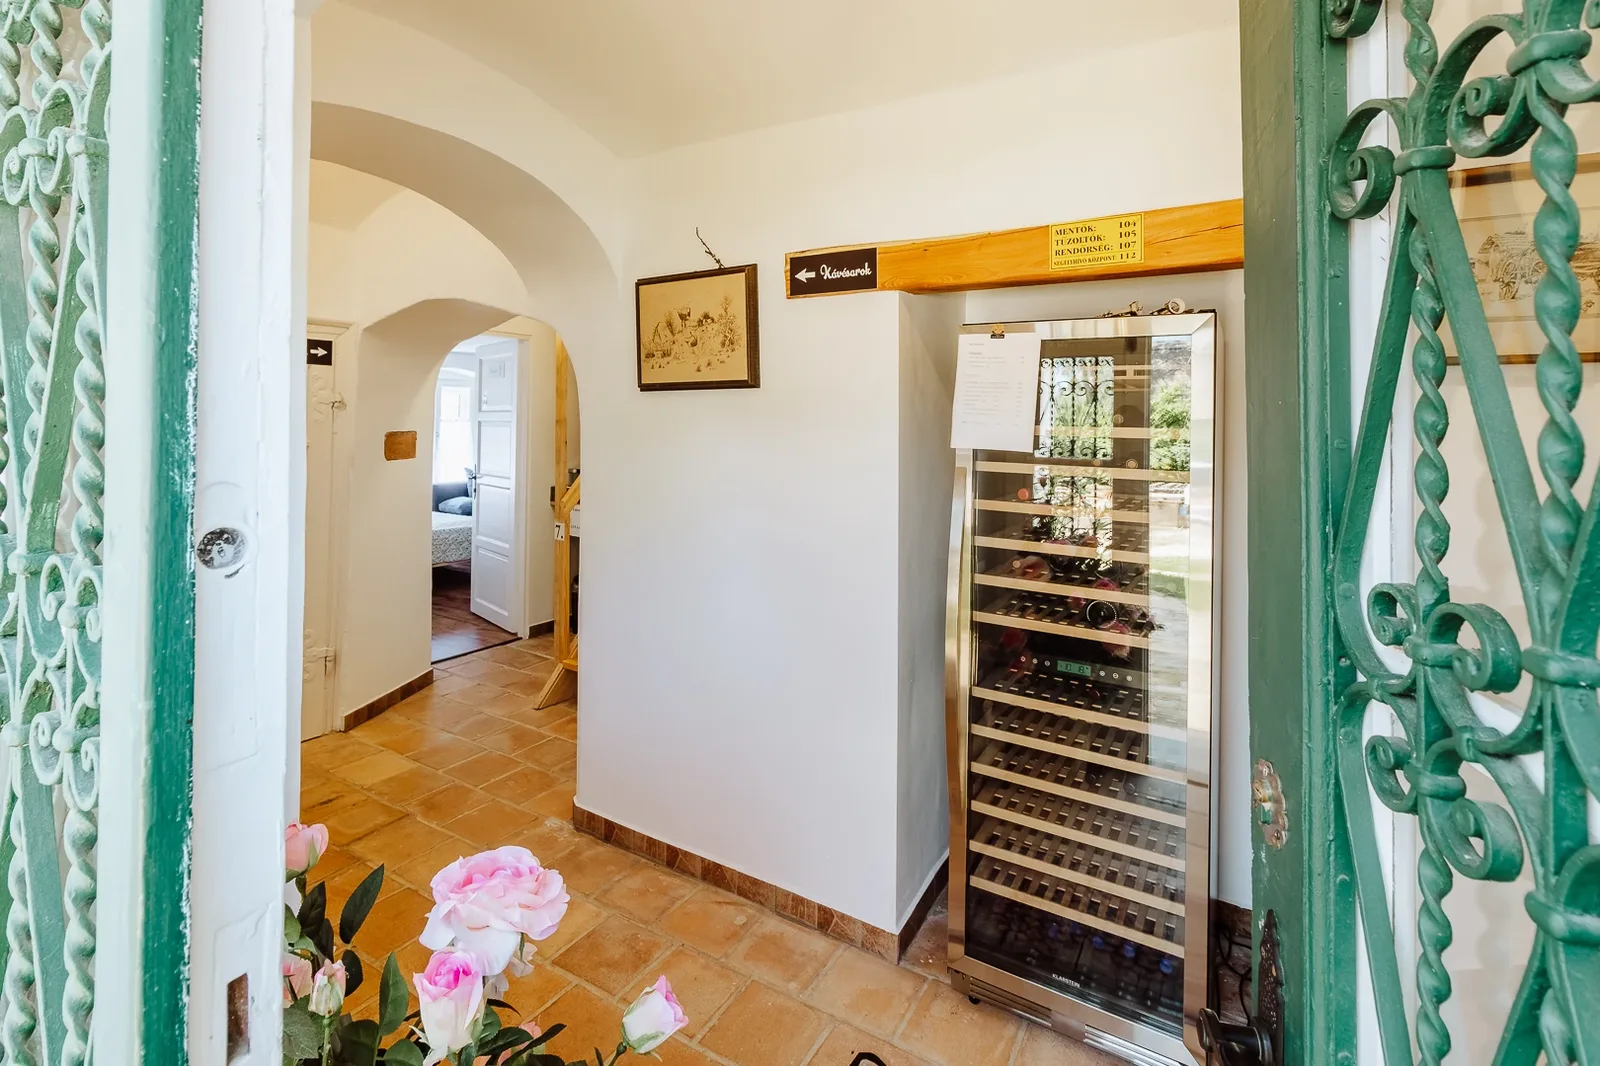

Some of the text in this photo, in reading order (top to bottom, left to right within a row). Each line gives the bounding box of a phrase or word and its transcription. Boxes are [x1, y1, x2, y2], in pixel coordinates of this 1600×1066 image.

[1055, 220, 1136, 236] MENTŐK: 104
[1119, 230, 1137, 238] 105
[1054, 241, 1137, 256] RENDŐRSÉG: 107
[1119, 252, 1136, 260] 112
[819, 262, 872, 280] Kávésarok
[554, 524, 564, 539] 7.
